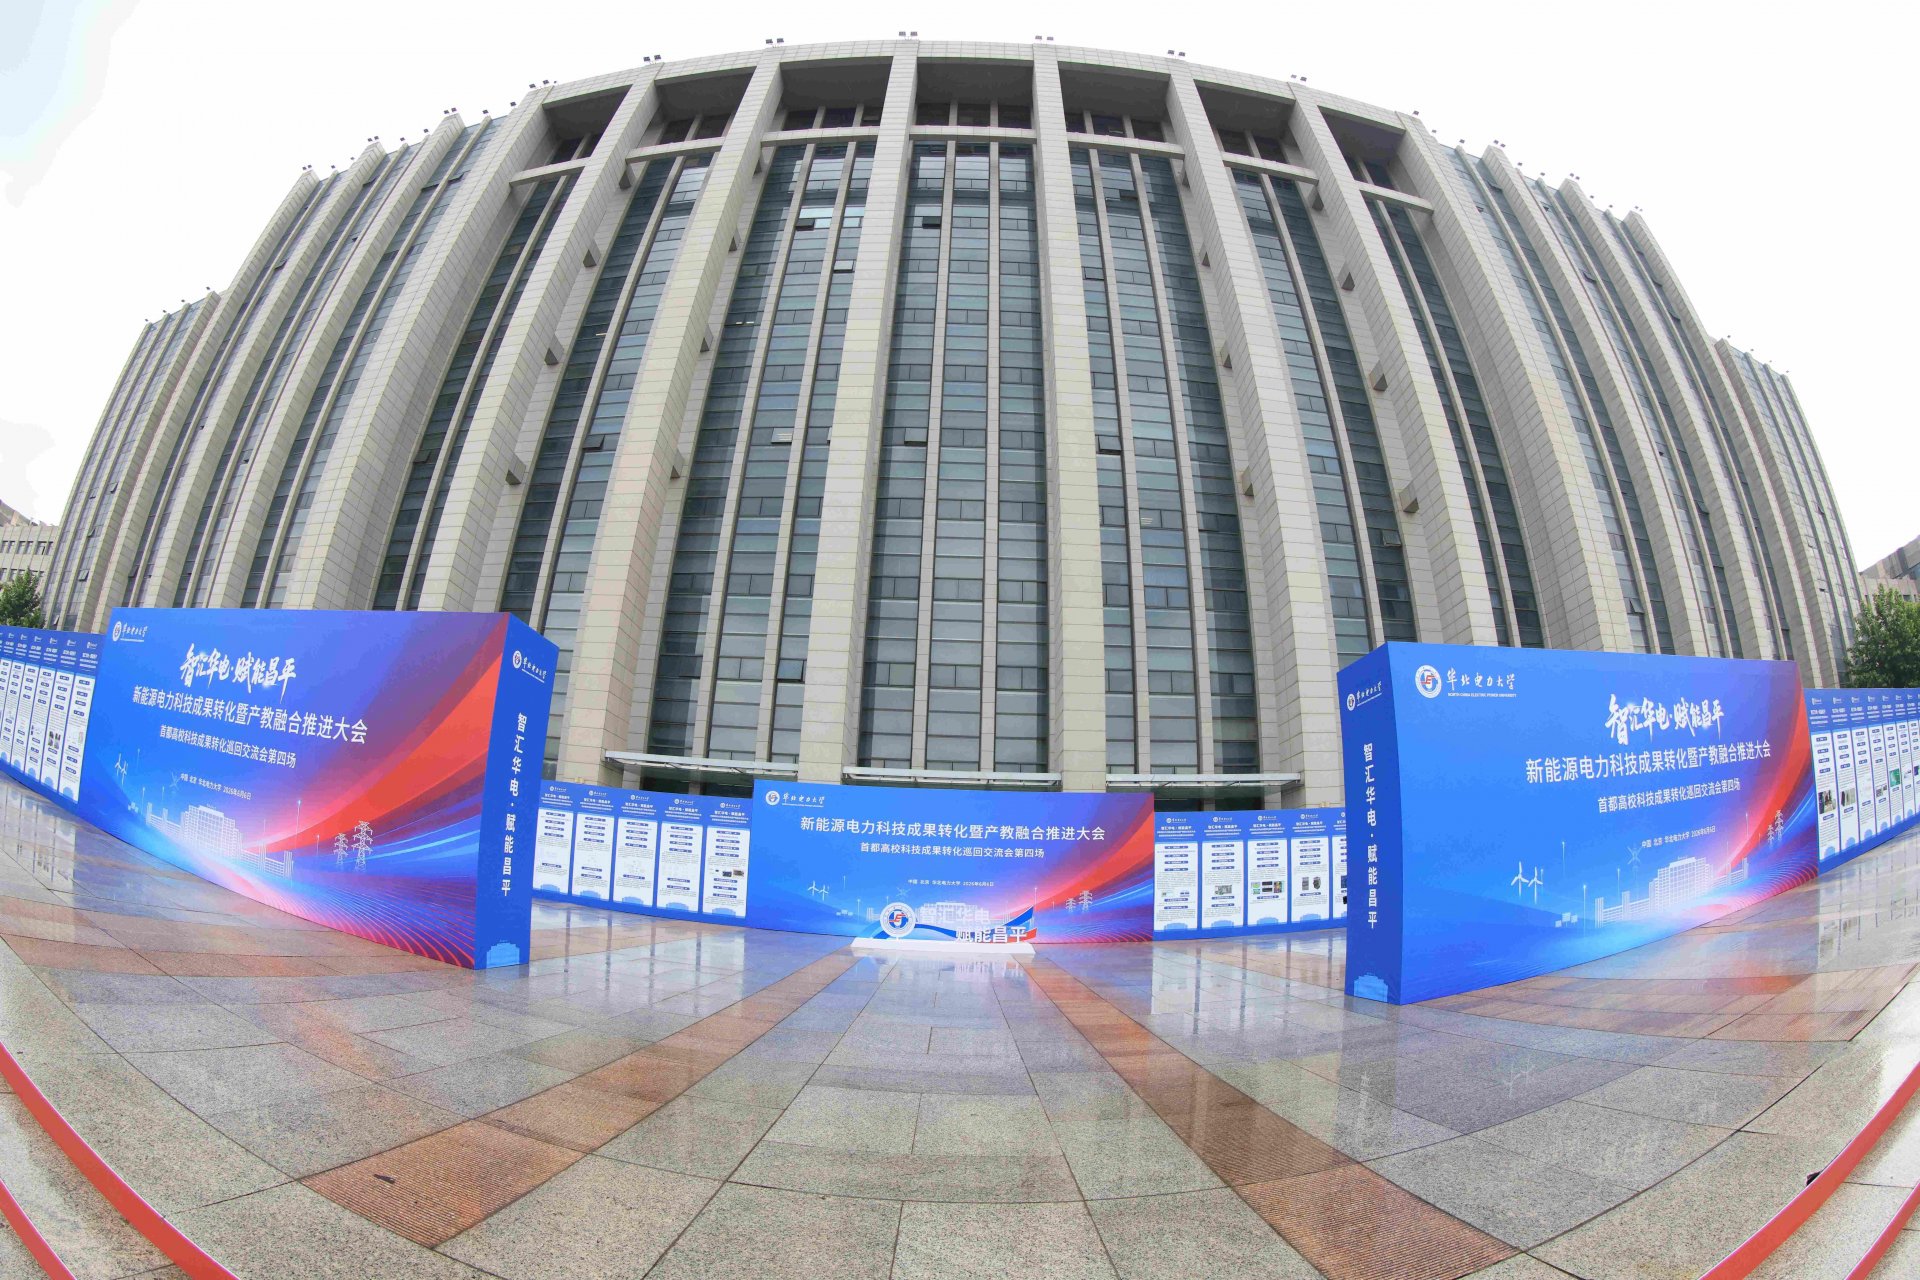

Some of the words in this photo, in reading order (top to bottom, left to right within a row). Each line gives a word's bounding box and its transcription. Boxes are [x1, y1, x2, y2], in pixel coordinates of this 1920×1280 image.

[1447, 667, 1515, 691] 华北电力大学
[133, 684, 368, 744] 新能源电力科技成果转化暨产教融合推进大会
[160, 724, 297, 769] 首都高校科技成果转化巡回交流会第四场
[1525, 739, 1771, 784] 新能源电力科技成果转化暨产教融合推进大会
[1598, 777, 1741, 814] 首都高校科技成果转化巡回交流会第四场
[800, 816, 1106, 841] 新能源电力科技成果转化暨产教融合推进大会
[860, 842, 1045, 858] 首都高校科技成果转化巡回交流会第四场
[919, 907, 990, 925] 智汇华电
[955, 926, 1027, 943] 赋能昌平
